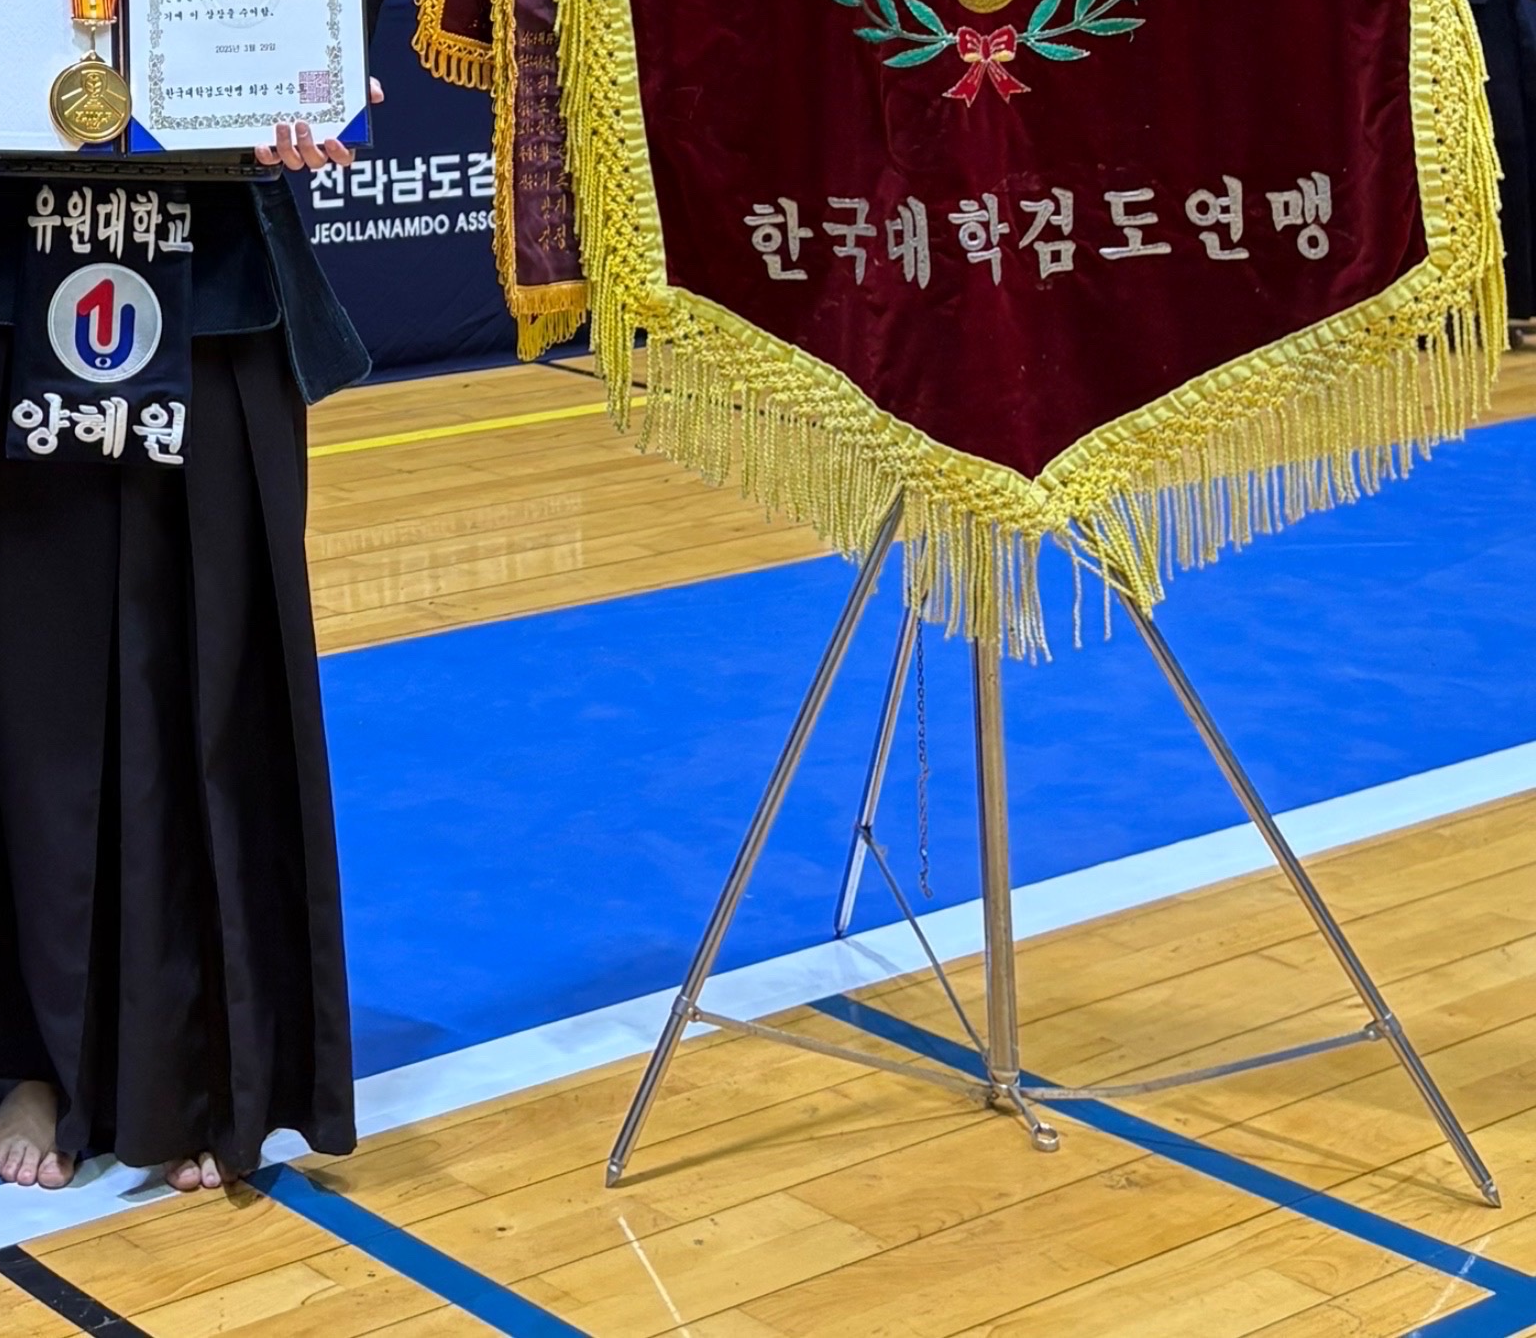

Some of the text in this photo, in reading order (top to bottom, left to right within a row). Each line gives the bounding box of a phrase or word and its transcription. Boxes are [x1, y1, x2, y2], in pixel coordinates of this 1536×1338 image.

[27, 183, 195, 263] 유원대학교
[310, 213, 451, 245] JEOLLANAMDO
[742, 170, 1335, 288] 한국대학검도연맹
[11, 392, 187, 466] 양혜원
